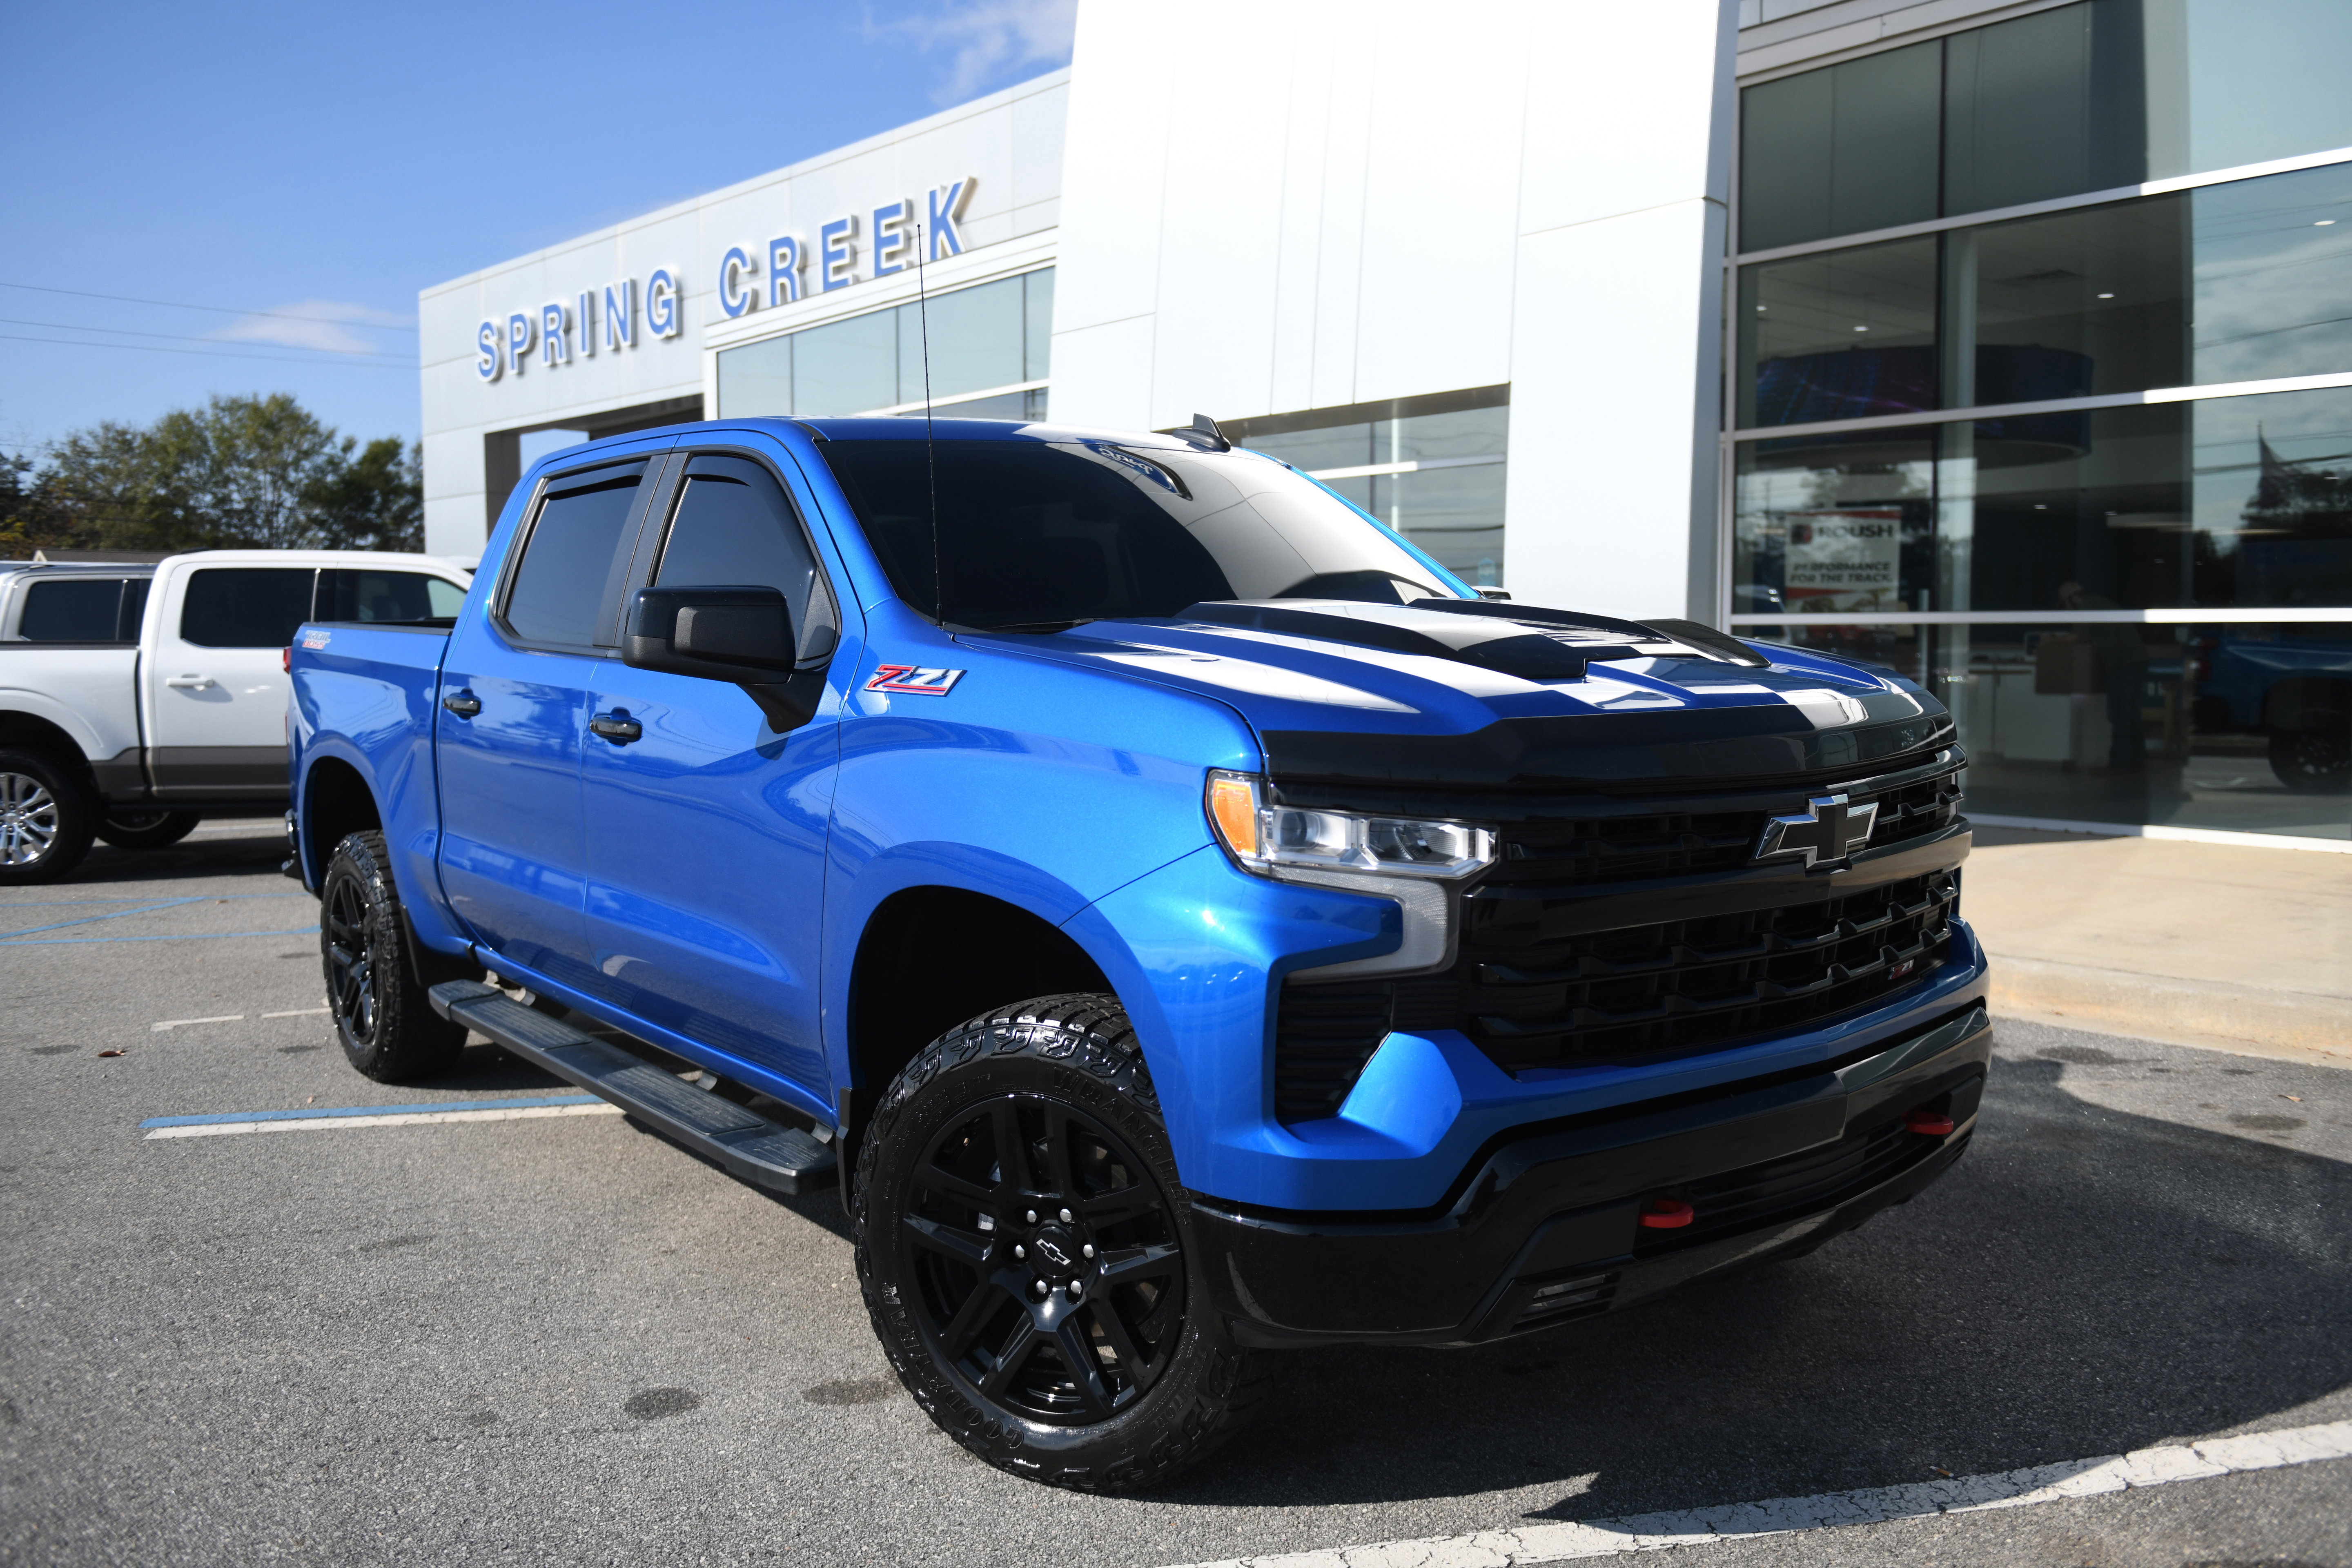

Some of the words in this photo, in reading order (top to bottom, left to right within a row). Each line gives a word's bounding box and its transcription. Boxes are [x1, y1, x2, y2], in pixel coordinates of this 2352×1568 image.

[476, 266, 681, 382] SPRING
[718, 177, 975, 318] CREEK
[1818, 525, 1893, 538] ROUSH
[1791, 574, 1815, 583] FOR
[1820, 574, 1842, 583] THE
[305, 630, 331, 643] TRAIL
[302, 639, 325, 650] BOSS
[864, 663, 968, 697] Z71
[881, 1281, 1025, 1449] GOODYEAR
